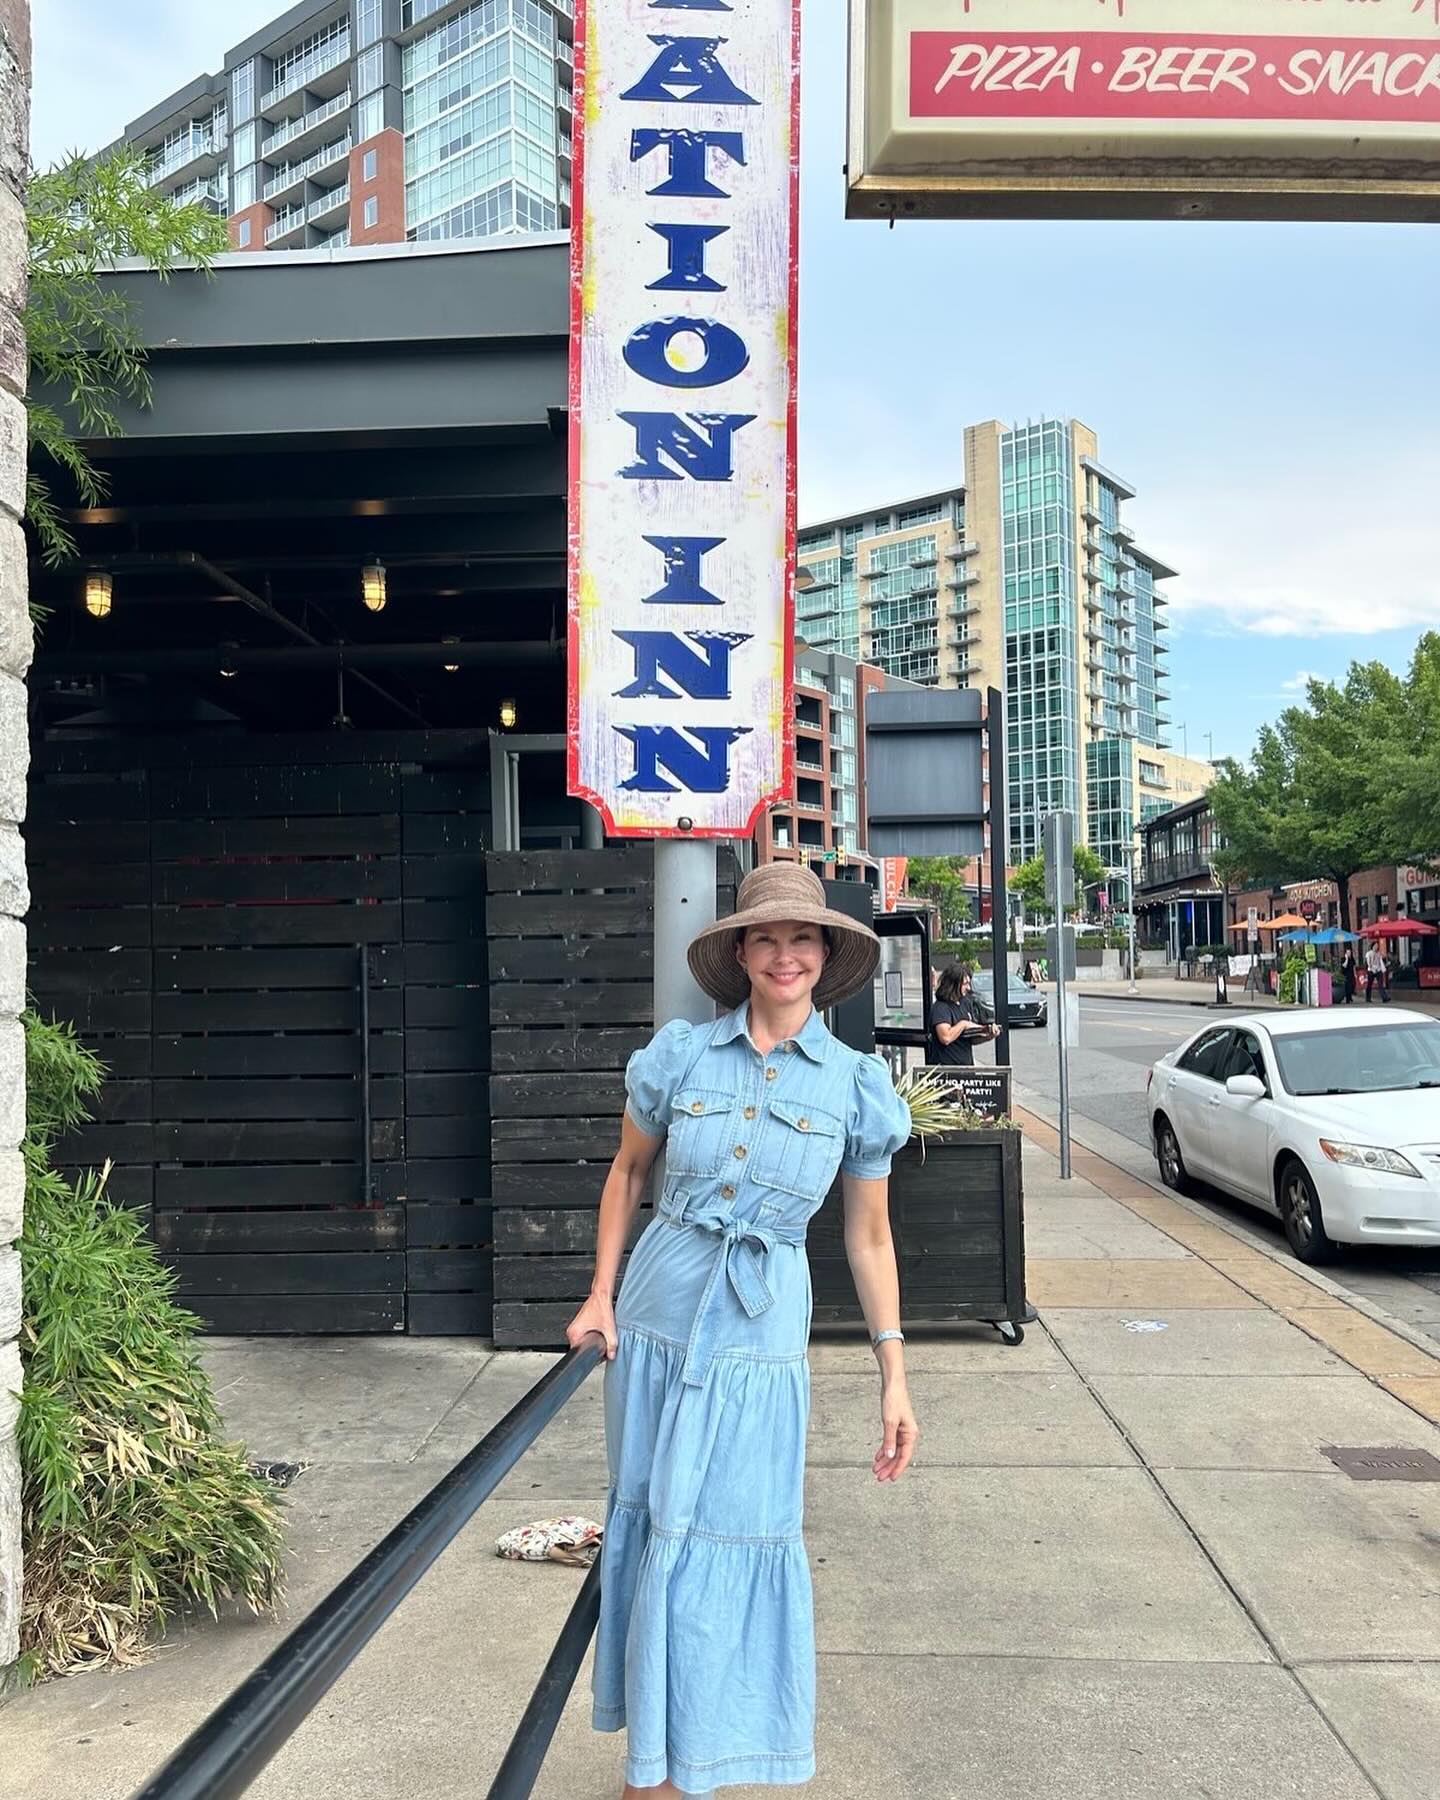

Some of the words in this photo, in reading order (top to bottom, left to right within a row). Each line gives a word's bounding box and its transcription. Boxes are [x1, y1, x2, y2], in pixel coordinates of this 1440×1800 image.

[935, 43, 1081, 95] PIZZA
[1108, 46, 1257, 96] BEER
[615, 0, 762, 482] ATION
[611, 534, 755, 793] INN
[960, 1079, 984, 1087] PARTY
[985, 1079, 1002, 1087] LIKE
